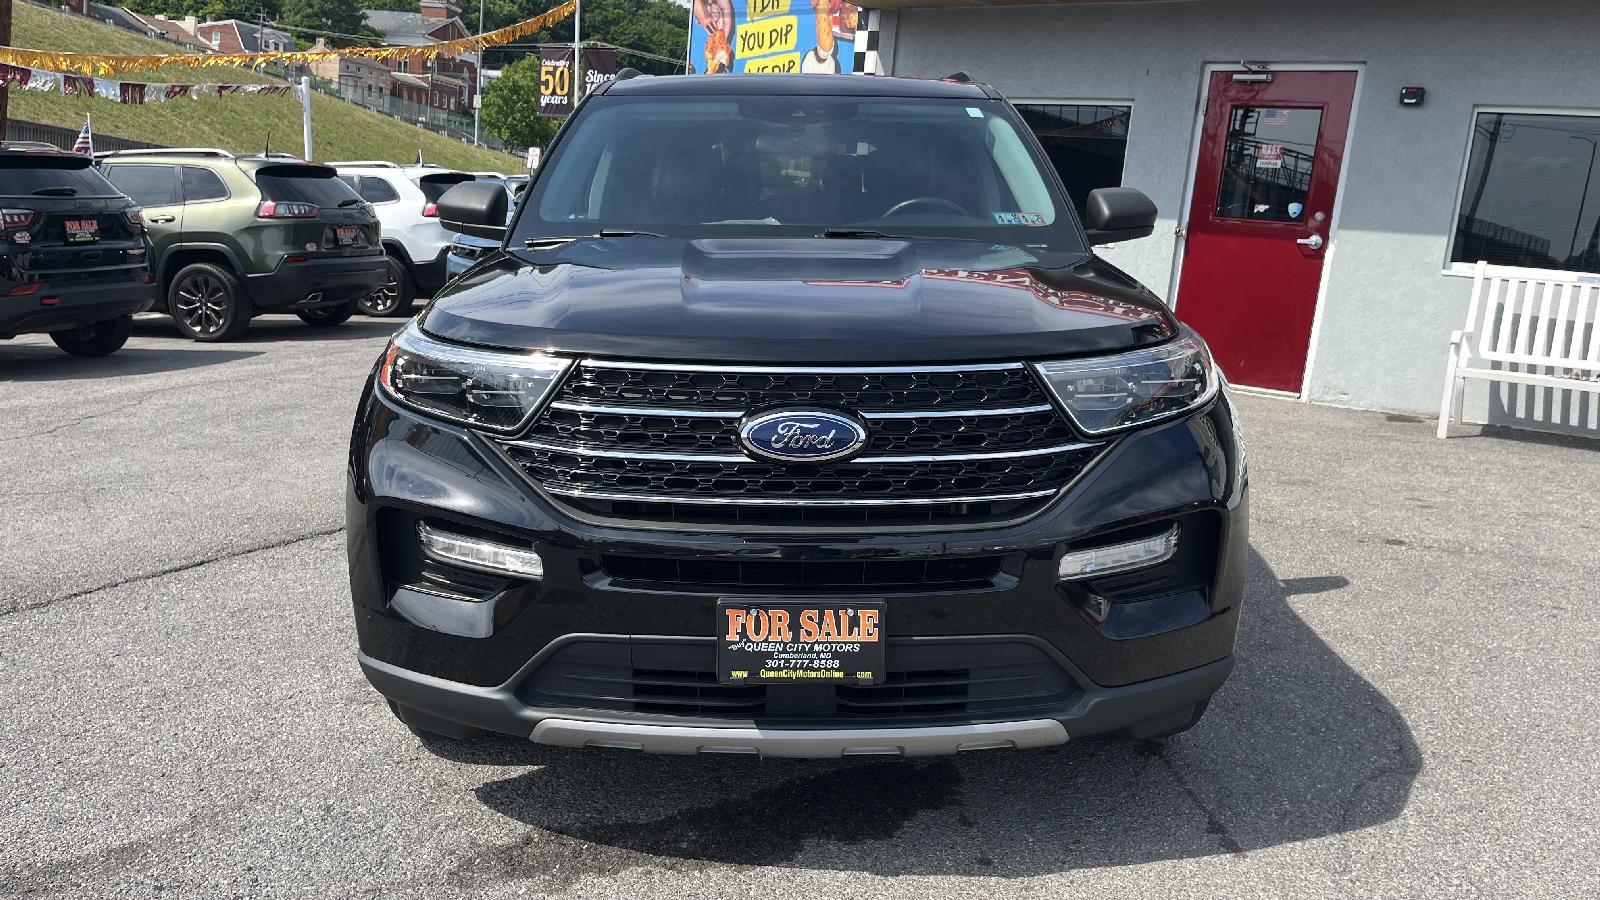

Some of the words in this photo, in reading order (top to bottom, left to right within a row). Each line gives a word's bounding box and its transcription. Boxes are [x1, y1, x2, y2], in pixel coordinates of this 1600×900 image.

[740, 30, 765, 53] YOU
[768, 23, 794, 49] DIP
[540, 66, 571, 96] 50
[585, 69, 616, 84] Since
[540, 95, 569, 107] years
[771, 421, 837, 449] Ford
[726, 609, 792, 642] FOR
[800, 609, 879, 642] SALE
[744, 642, 784, 652] QUEEN
[786, 642, 811, 652] CITY
[813, 643, 861, 652] MOTORS
[773, 652, 818, 660] Cumberland,
[764, 659, 840, 669] 301-777-8588
